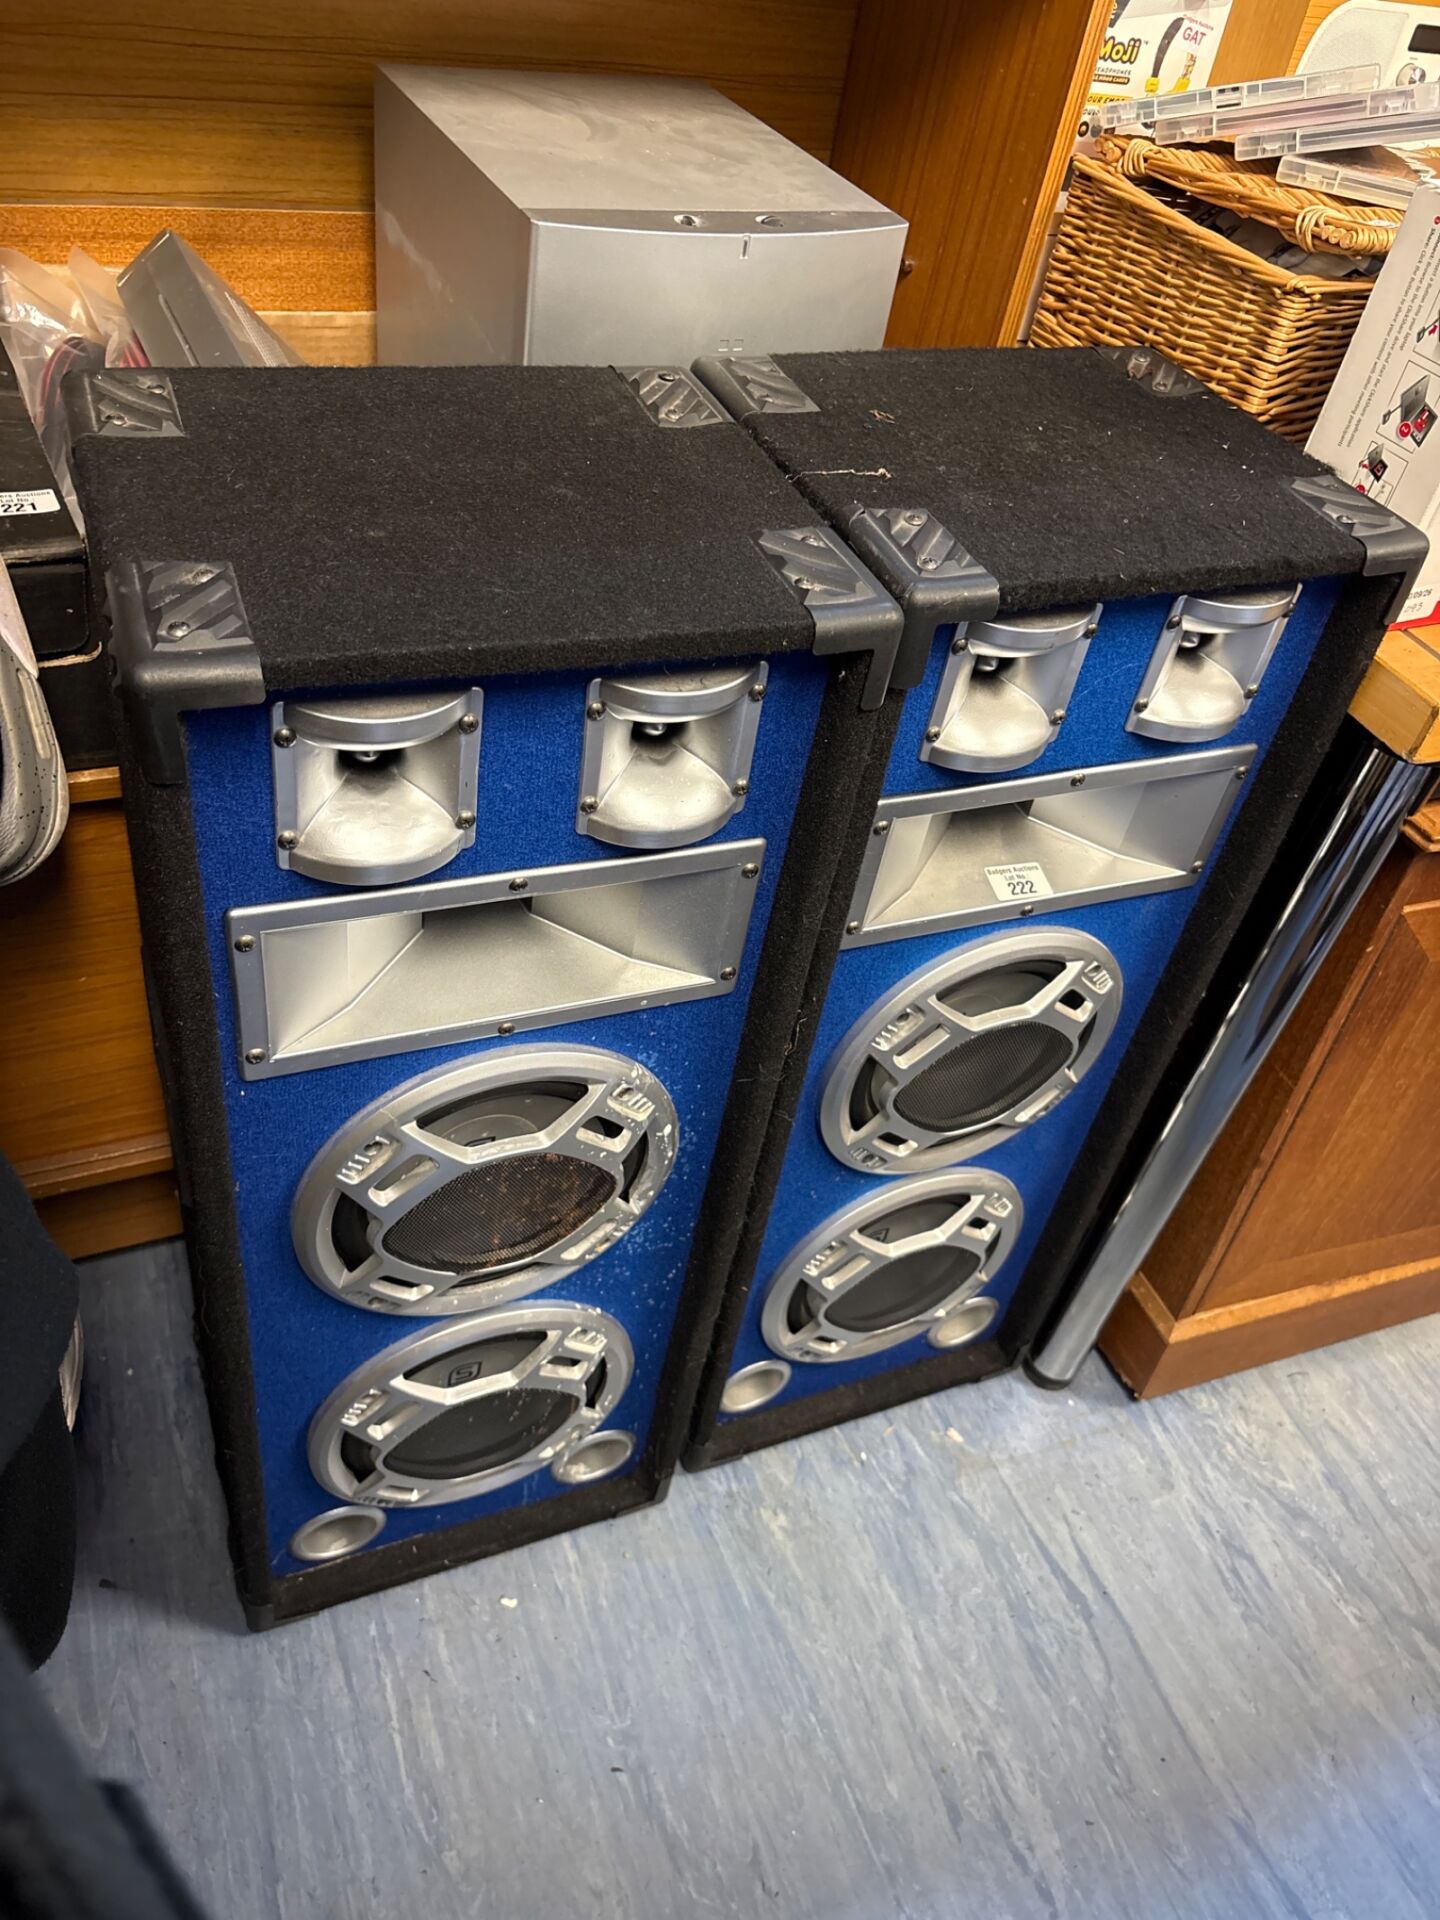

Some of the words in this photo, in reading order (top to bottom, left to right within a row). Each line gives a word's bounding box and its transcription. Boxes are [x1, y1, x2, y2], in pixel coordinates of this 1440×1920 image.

[1182, 26, 1206, 46] GAT
[1095, 66, 1131, 76] EADPHONES
[1, 502, 37, 512] 221
[1007, 880, 1037, 896] 222
